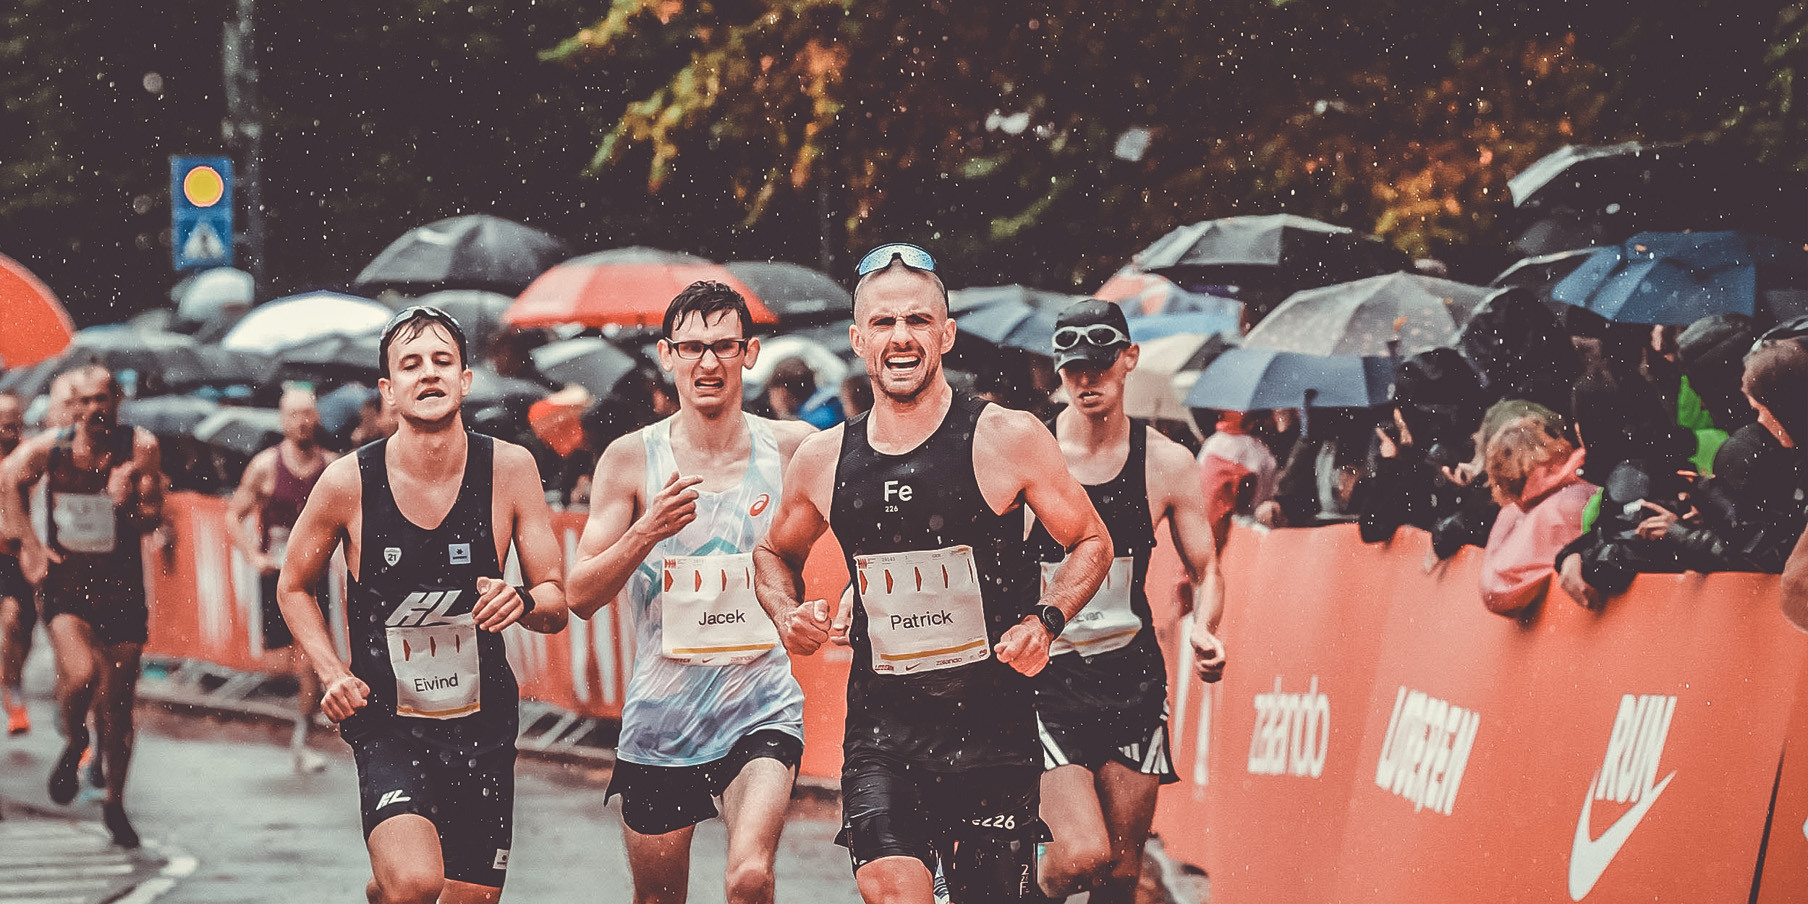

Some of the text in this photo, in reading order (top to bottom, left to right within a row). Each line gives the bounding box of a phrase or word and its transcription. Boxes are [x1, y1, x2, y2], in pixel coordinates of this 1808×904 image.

[884, 480, 913, 502] Fe
[885, 505, 899, 513] 226
[387, 553, 397, 562] 21
[698, 609, 746, 626] Jacek
[890, 610, 954, 630] Patrick
[414, 673, 459, 692] Eivind
[1247, 674, 1331, 779] zalando
[1594, 693, 1678, 804] RUN
